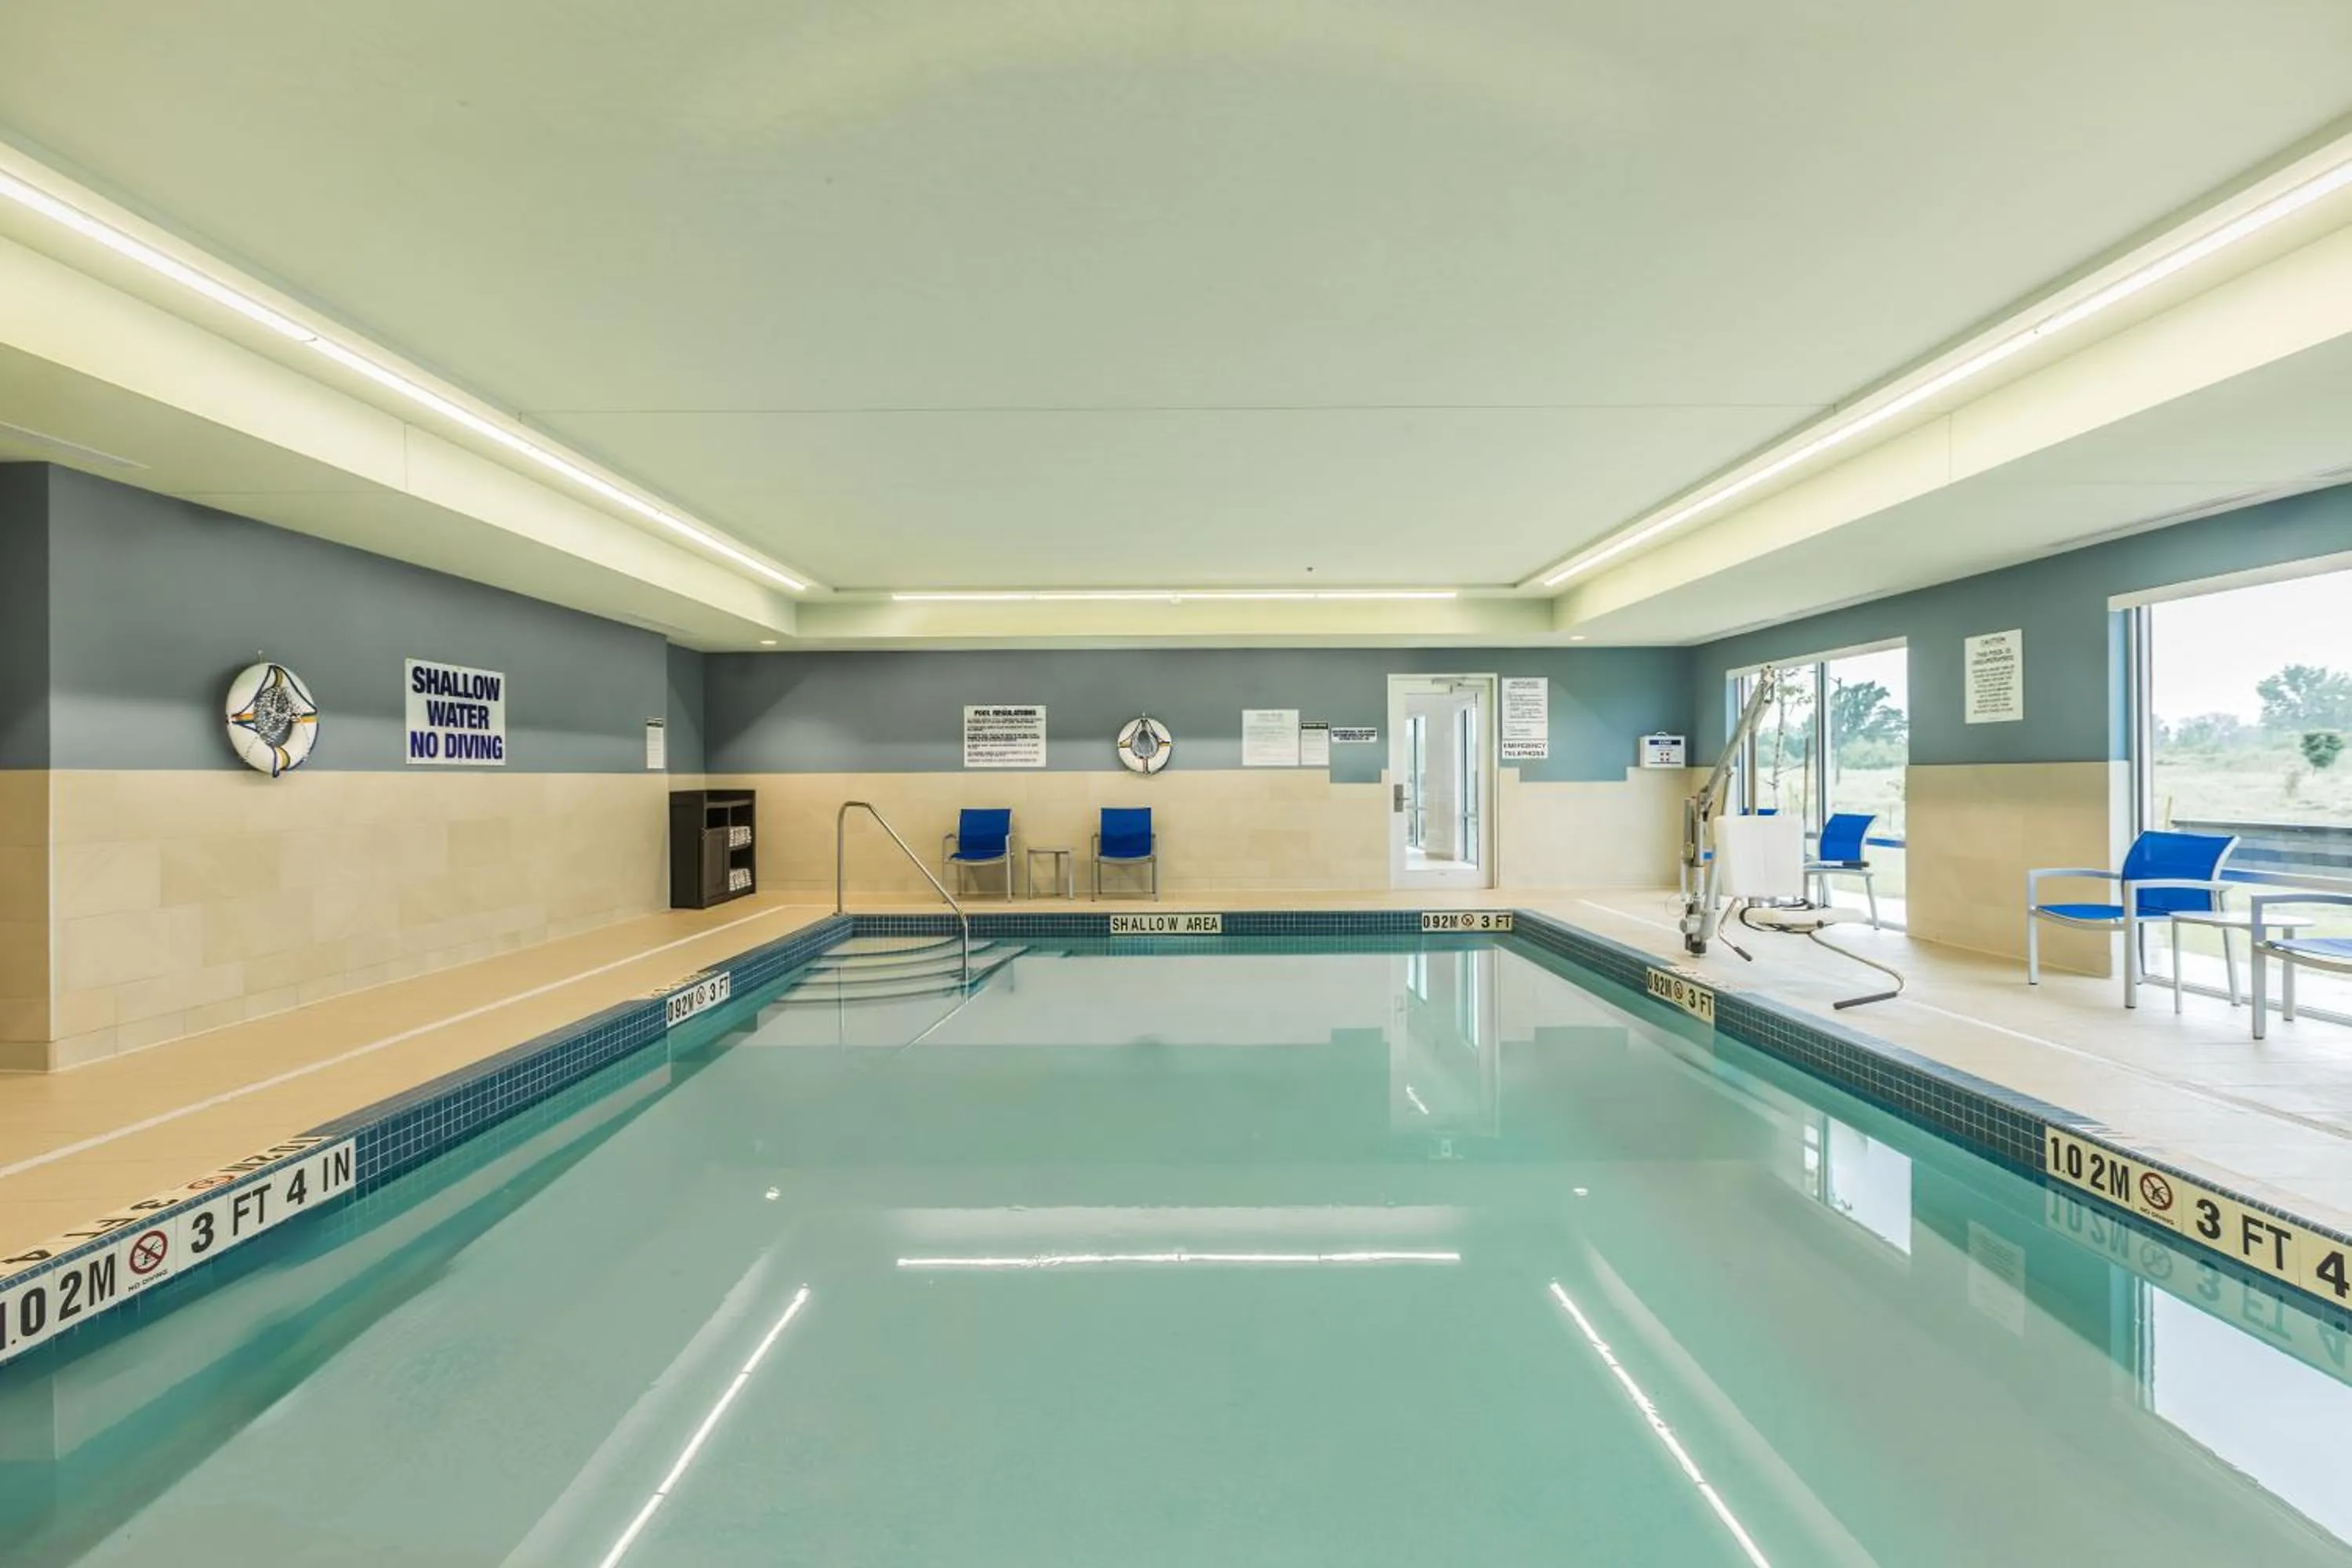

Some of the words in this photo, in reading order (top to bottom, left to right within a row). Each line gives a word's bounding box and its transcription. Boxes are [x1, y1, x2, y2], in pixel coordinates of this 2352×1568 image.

[412, 666, 500, 701] SHALLOW
[426, 700, 489, 729] WATER
[410, 731, 438, 758] NO
[445, 733, 503, 759] DIVING
[1112, 917, 1178, 931] SHALLOW
[1186, 917, 1218, 931] AREA
[1481, 915, 1490, 928] 3
[1495, 915, 1512, 928] FT
[710, 982, 716, 1002] 3
[719, 976, 728, 997] FT
[1689, 989, 1696, 1008] 3
[1700, 992, 1712, 1016] FT
[191, 1211, 214, 1253] 3
[233, 1183, 271, 1236] FT
[286, 1167, 307, 1205] 4
[323, 1147, 350, 1192] IN
[2051, 1137, 2129, 1202] 1.02M
[2196, 1199, 2221, 1240] 3
[2242, 1214, 2292, 1270] FT
[2316, 1250, 2350, 1298] 4
[128, 1282, 140, 1292] NO
[142, 1269, 168, 1285] DIVING
